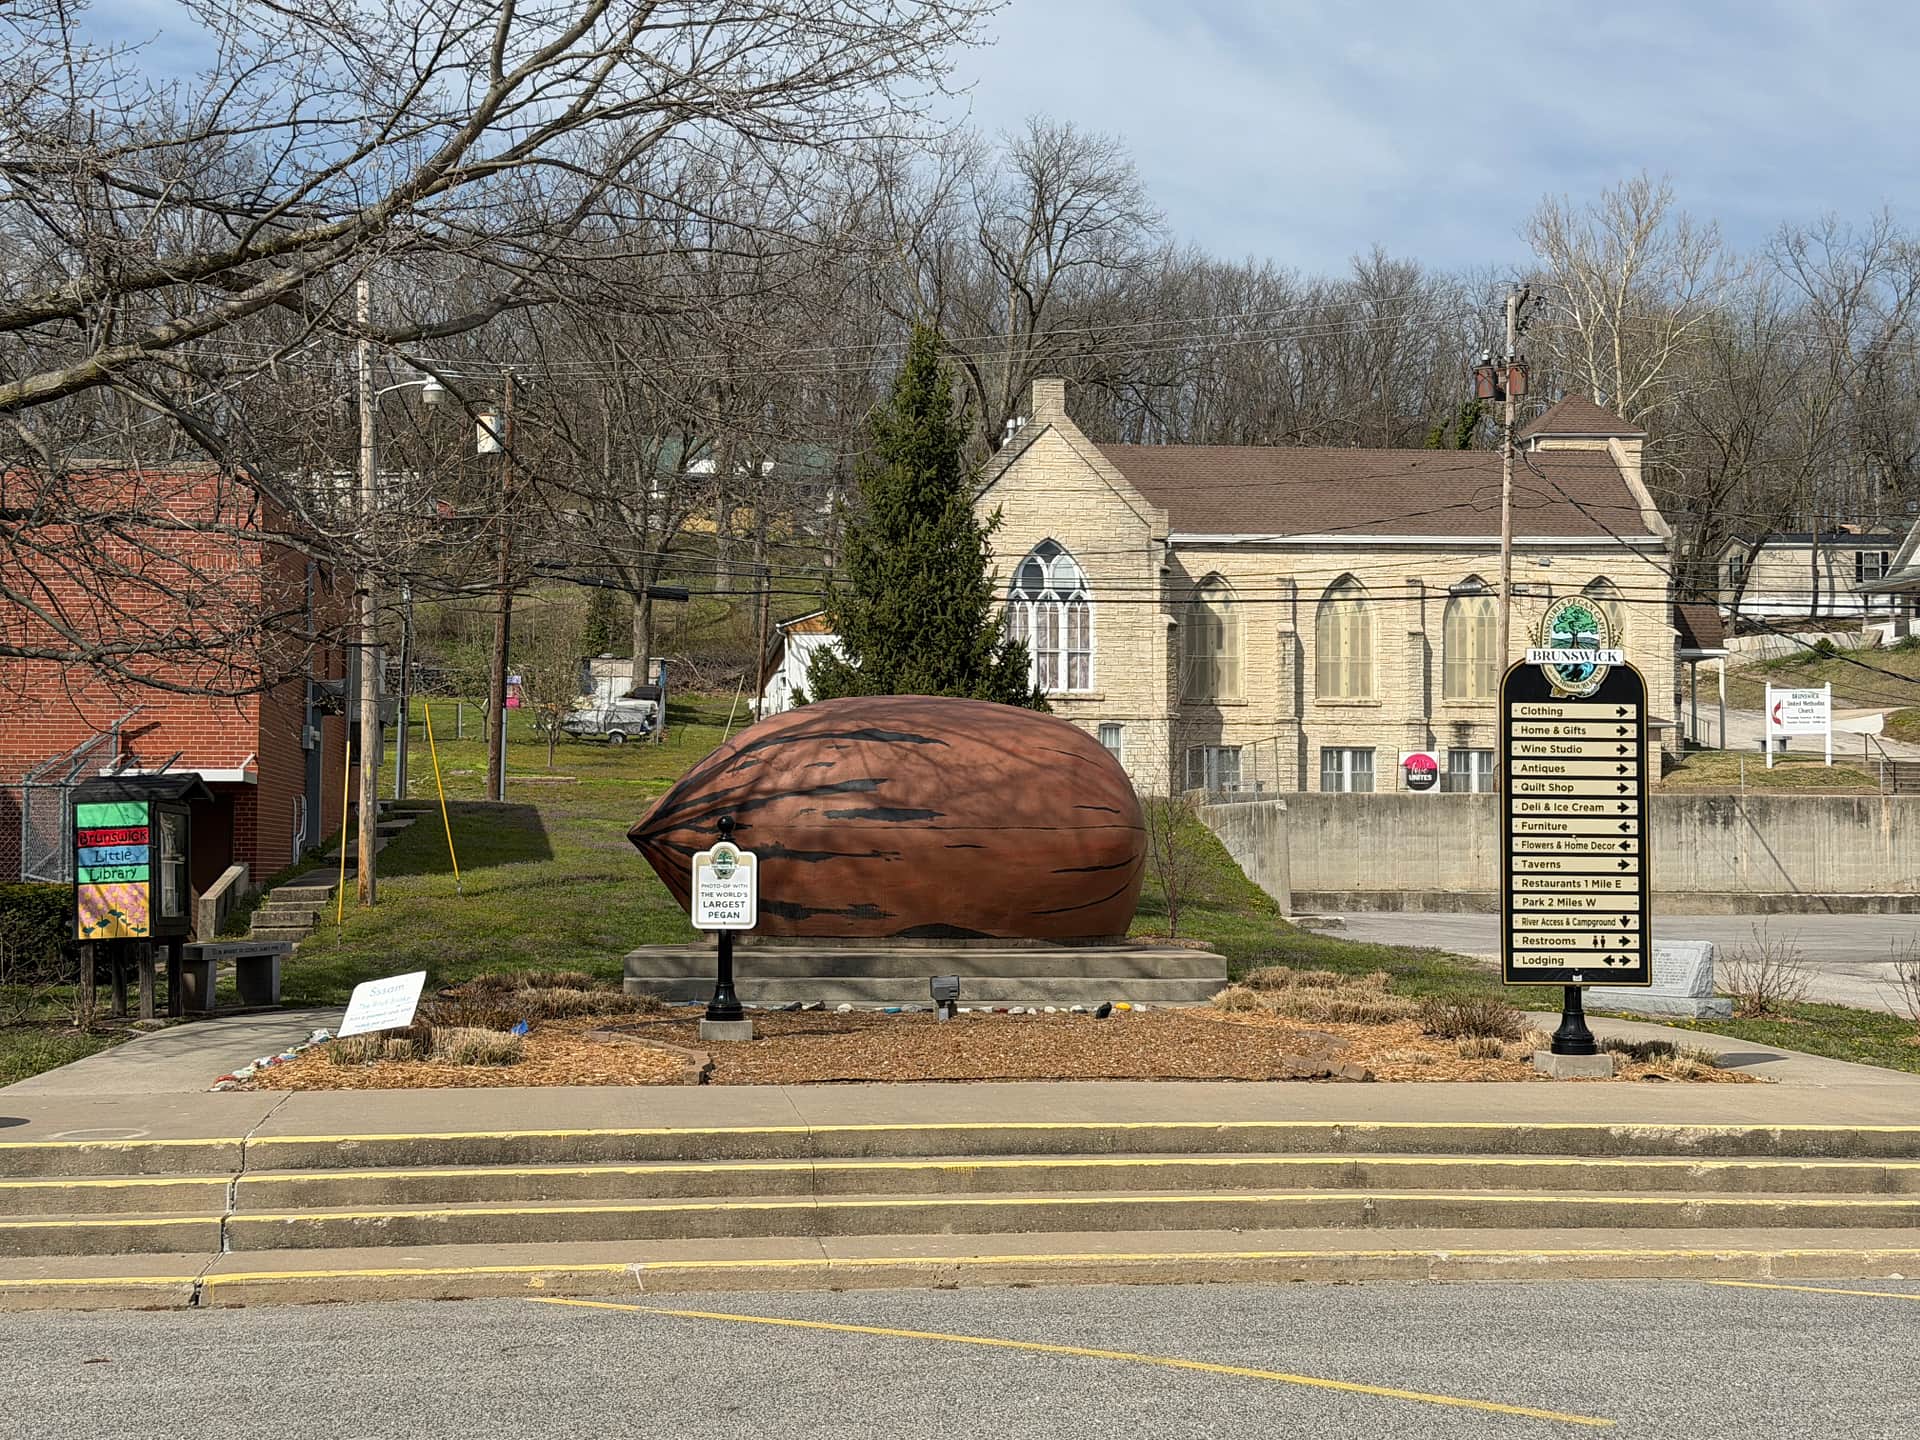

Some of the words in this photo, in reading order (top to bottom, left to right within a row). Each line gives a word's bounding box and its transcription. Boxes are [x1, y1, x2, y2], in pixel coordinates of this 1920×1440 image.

[1568, 597, 1595, 611] PECAN
[1593, 610, 1607, 645] CAPITAL
[1532, 650, 1619, 663] BRUNSWICK
[1520, 706, 1563, 717] Clothing
[1520, 725, 1550, 735] Home
[1553, 726, 1560, 735] &
[1562, 726, 1587, 735] Gifts
[1520, 744, 1547, 753] Wine
[1550, 744, 1583, 753] Studio
[1520, 764, 1566, 773] Antiques
[1520, 782, 1546, 791] Quilt
[1548, 783, 1574, 793] Shop
[1521, 802, 1541, 811] Deli
[1543, 802, 1551, 811] &
[1553, 802, 1569, 811] Ice
[1571, 803, 1605, 812] Cream
[1521, 821, 1568, 831] Furniture
[1521, 840, 1554, 849] Flowers
[1556, 841, 1562, 850] &
[1564, 841, 1589, 850] Home
[1591, 841, 1616, 850] Decor
[95, 850, 134, 863] Little
[1521, 860, 1561, 869] Taverns
[89, 867, 137, 881] Library
[1521, 879, 1581, 888] Restaurants
[1592, 879, 1612, 888] Mile
[1615, 879, 1622, 888] E
[1522, 898, 1544, 907] Park
[1548, 898, 1554, 907] 2
[1557, 898, 1583, 907] Miles
[1586, 898, 1597, 907] W
[1521, 917, 1539, 926] River
[1541, 917, 1564, 926] Access
[1565, 918, 1570, 926] &
[1572, 918, 1616, 928] Campground
[1522, 936, 1576, 945] Restrooms
[1522, 956, 1565, 966] Lodging
